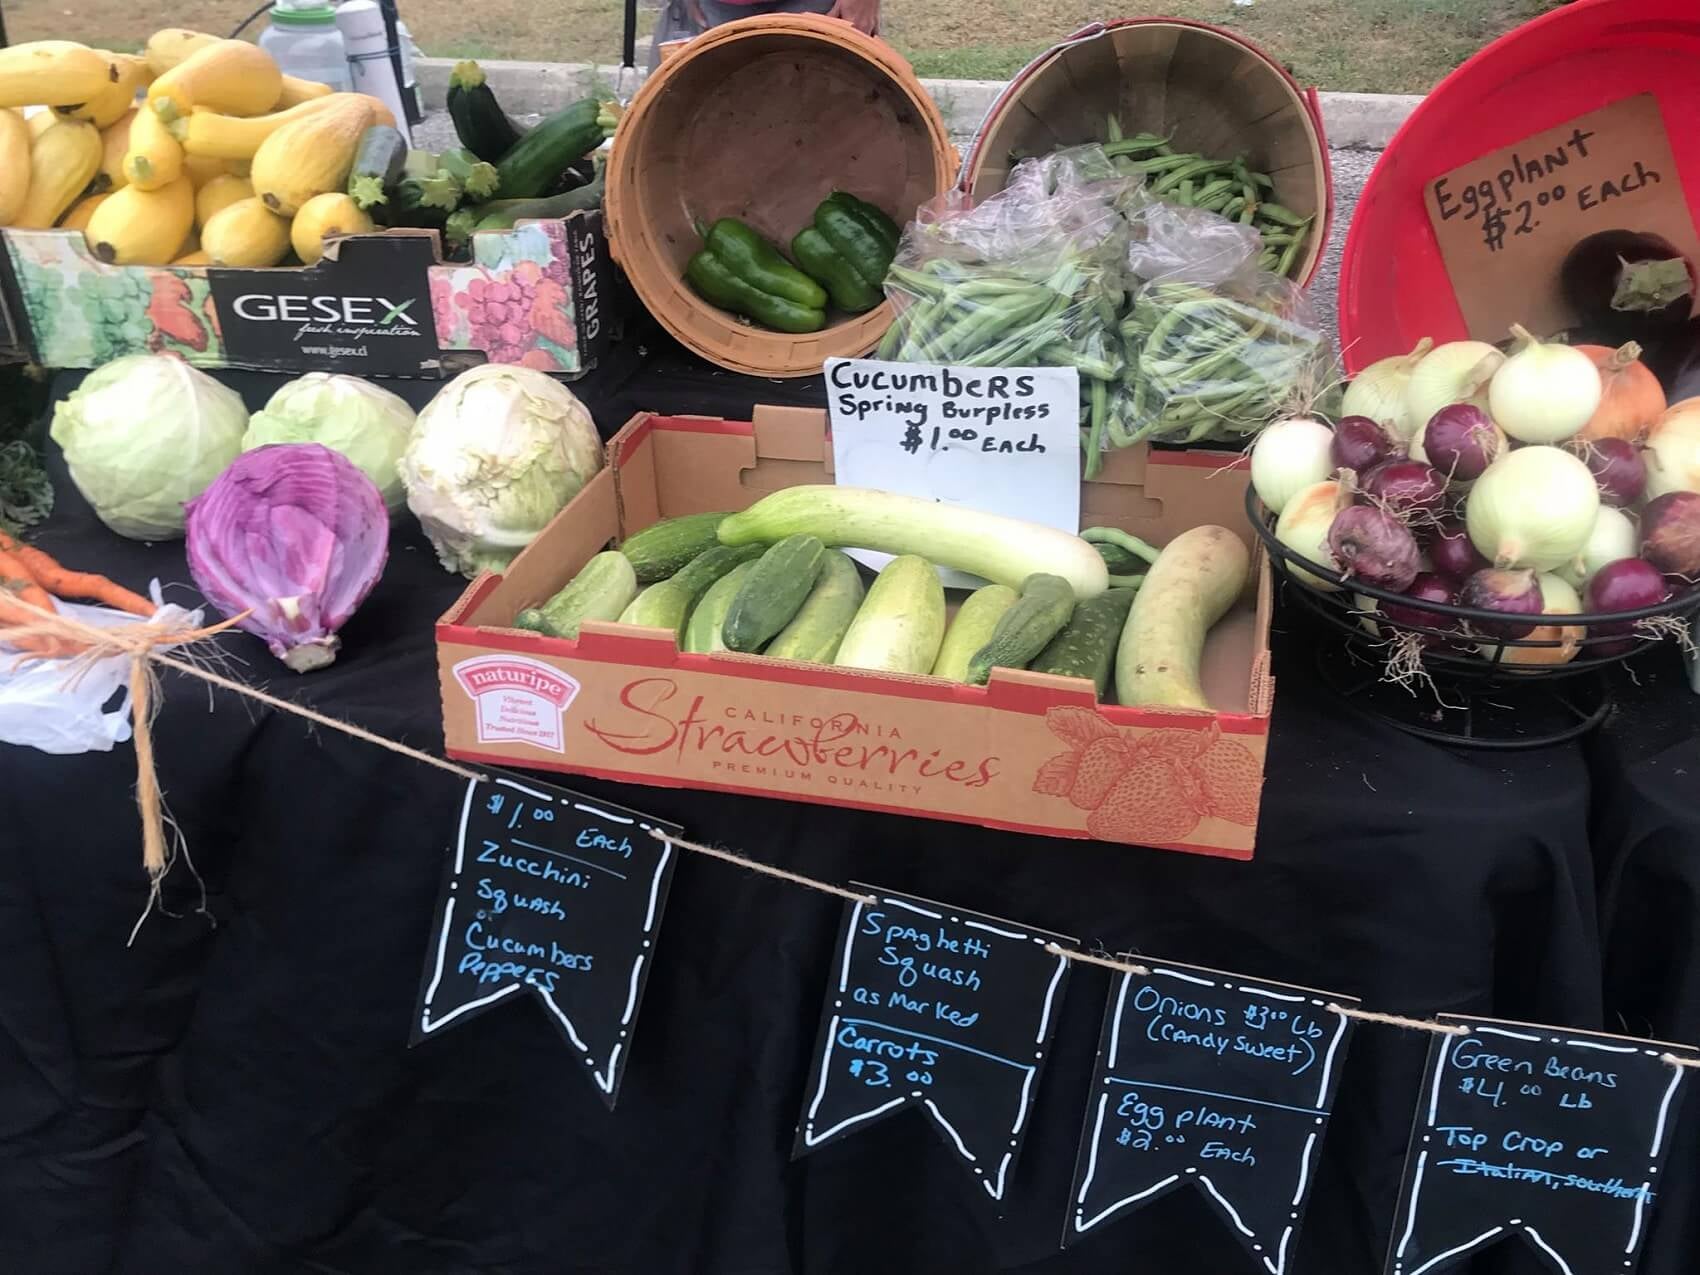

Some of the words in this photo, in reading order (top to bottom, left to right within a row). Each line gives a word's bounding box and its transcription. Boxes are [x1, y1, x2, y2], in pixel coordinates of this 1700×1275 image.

[579, 232, 600, 340] GRAPES
[232, 294, 418, 325] GESEX
[293, 322, 333, 341] fresh
[337, 322, 421, 340] inspiration
[301, 345, 368, 358] www.gesex.cl
[472, 668, 561, 695] naturipe
[583, 678, 1001, 788] Strawberries
[725, 706, 902, 740] CALIFORNIA
[712, 760, 813, 781] PREMIUM
[828, 775, 923, 795] QUALITY
[476, 840, 592, 888] Zucchini
[853, 987, 880, 1004] as
[1133, 985, 1226, 1025] Onions
[837, 1025, 938, 1065] Carrots
[1451, 1039, 1533, 1074] Green
[1543, 1056, 1618, 1088] Beans
[1436, 1127, 1488, 1151] Top
[1502, 1131, 1564, 1157] Crop
[1576, 1146, 1609, 1159] or
